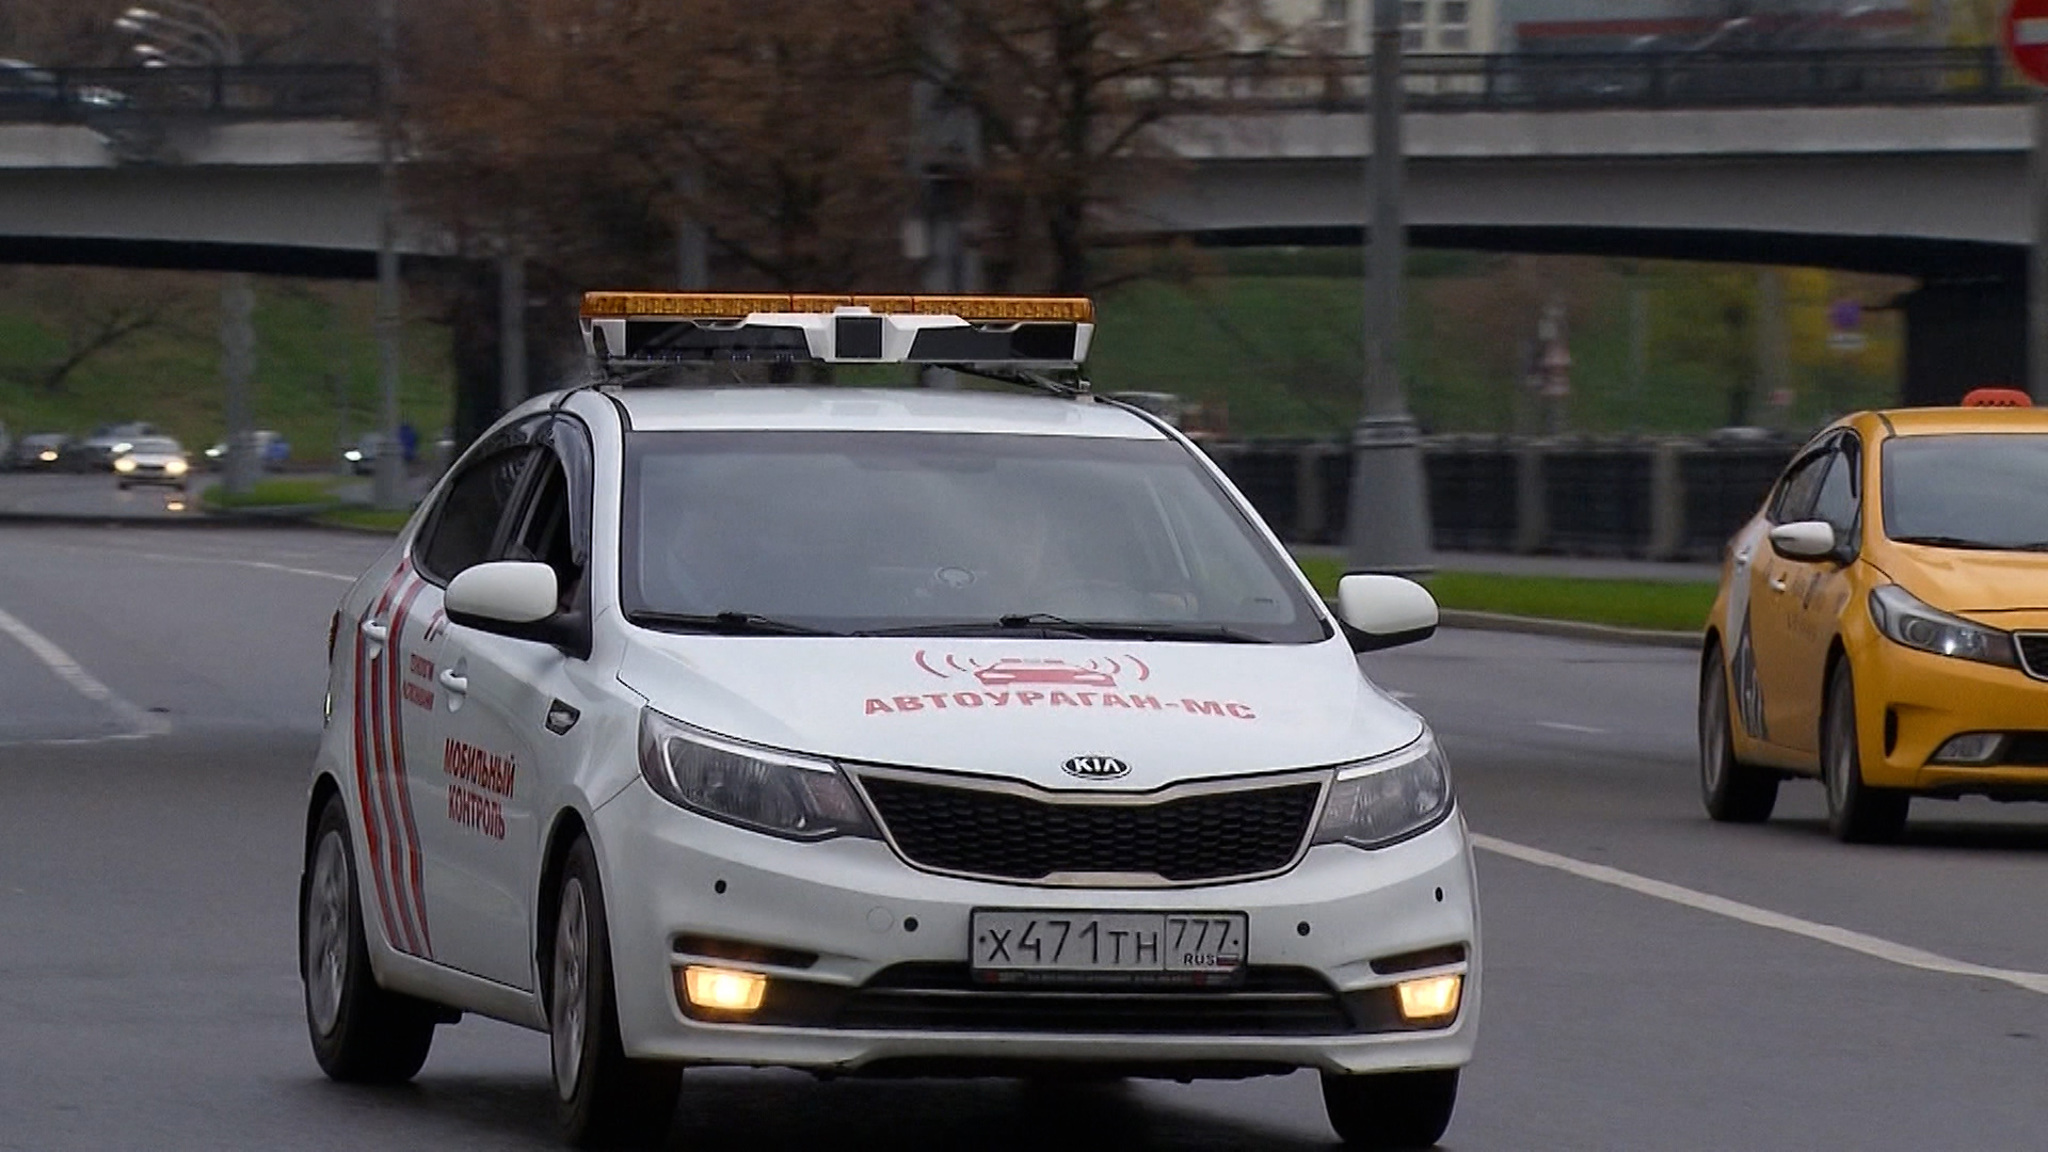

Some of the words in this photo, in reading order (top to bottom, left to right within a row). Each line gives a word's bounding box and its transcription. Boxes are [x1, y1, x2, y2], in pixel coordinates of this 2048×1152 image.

[864, 690, 1257, 720] АВТОУРАГАН-МС
[444, 737, 516, 800] МОБИЛЬНЫЙ
[1074, 757, 1121, 773] KIA
[447, 784, 506, 840] КОНТРОЛЬ
[1169, 918, 1231, 954] 777
[1183, 952, 1215, 966] RUS
